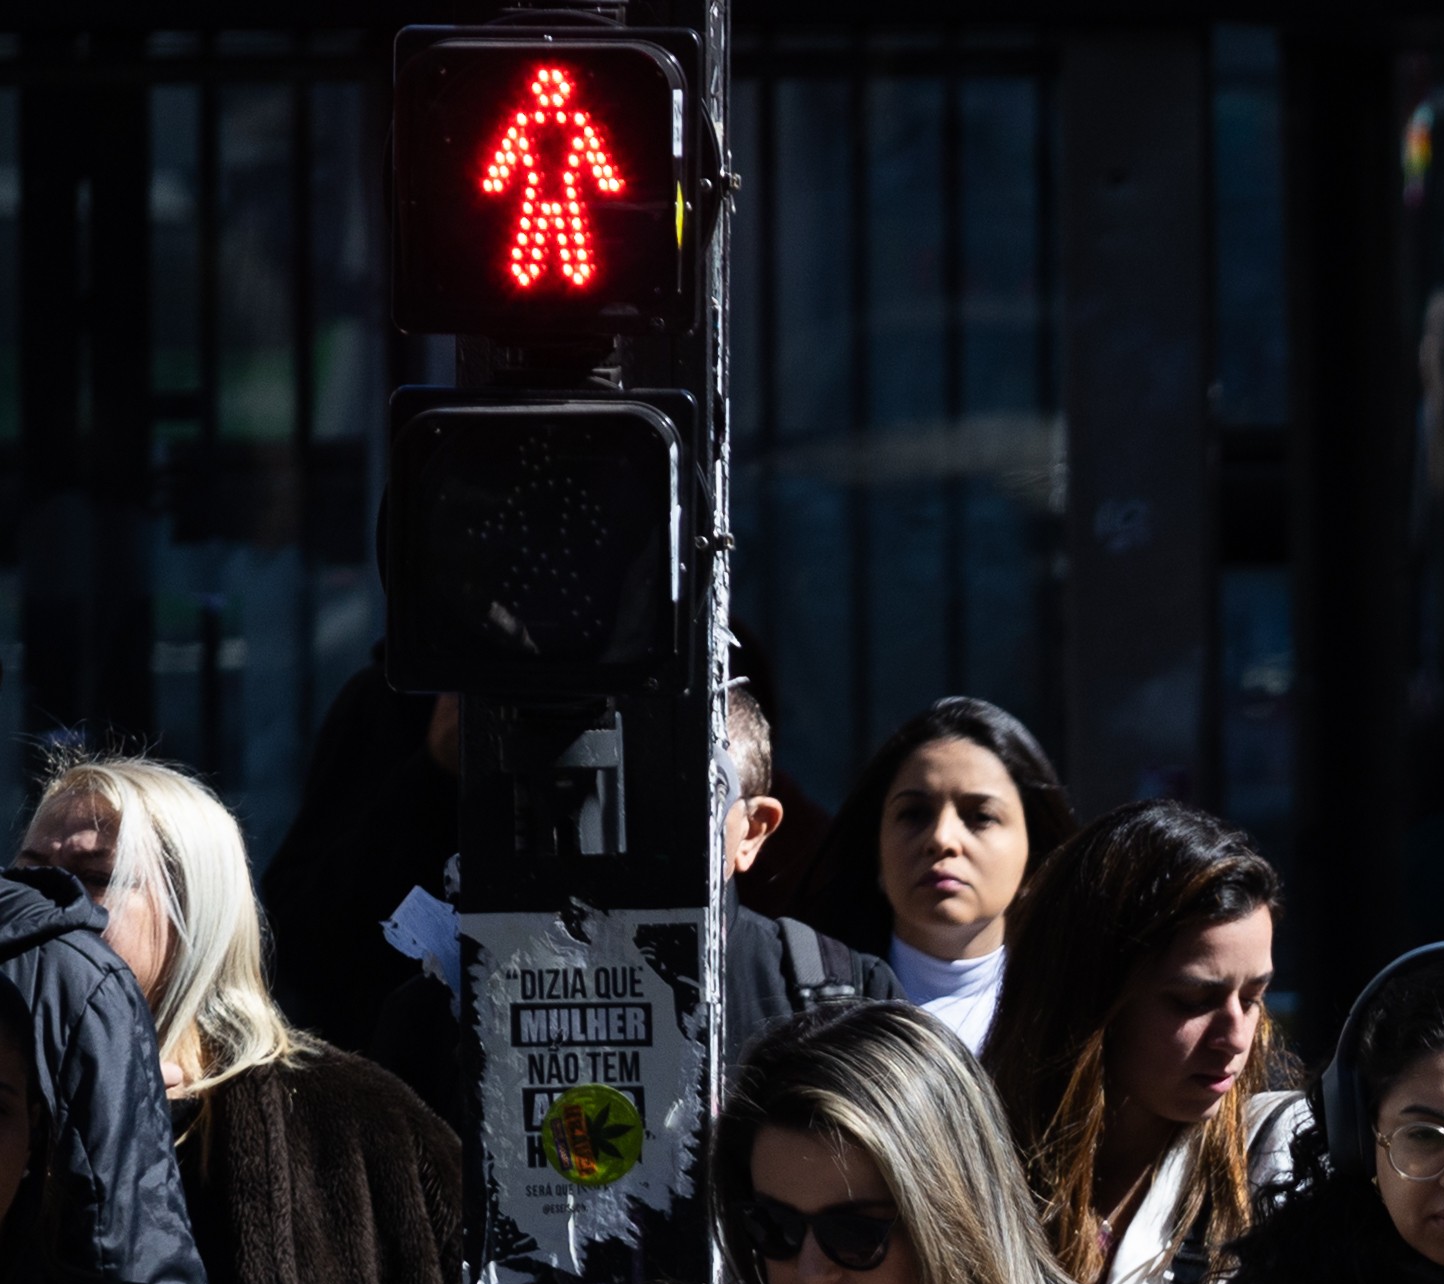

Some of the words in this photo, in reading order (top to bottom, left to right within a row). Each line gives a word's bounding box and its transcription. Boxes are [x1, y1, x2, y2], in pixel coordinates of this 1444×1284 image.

[595, 966, 643, 999] QUE
[520, 1007, 646, 1043] MULHER
[528, 1047, 579, 1084] NÃO
[586, 1050, 640, 1083] TEM
